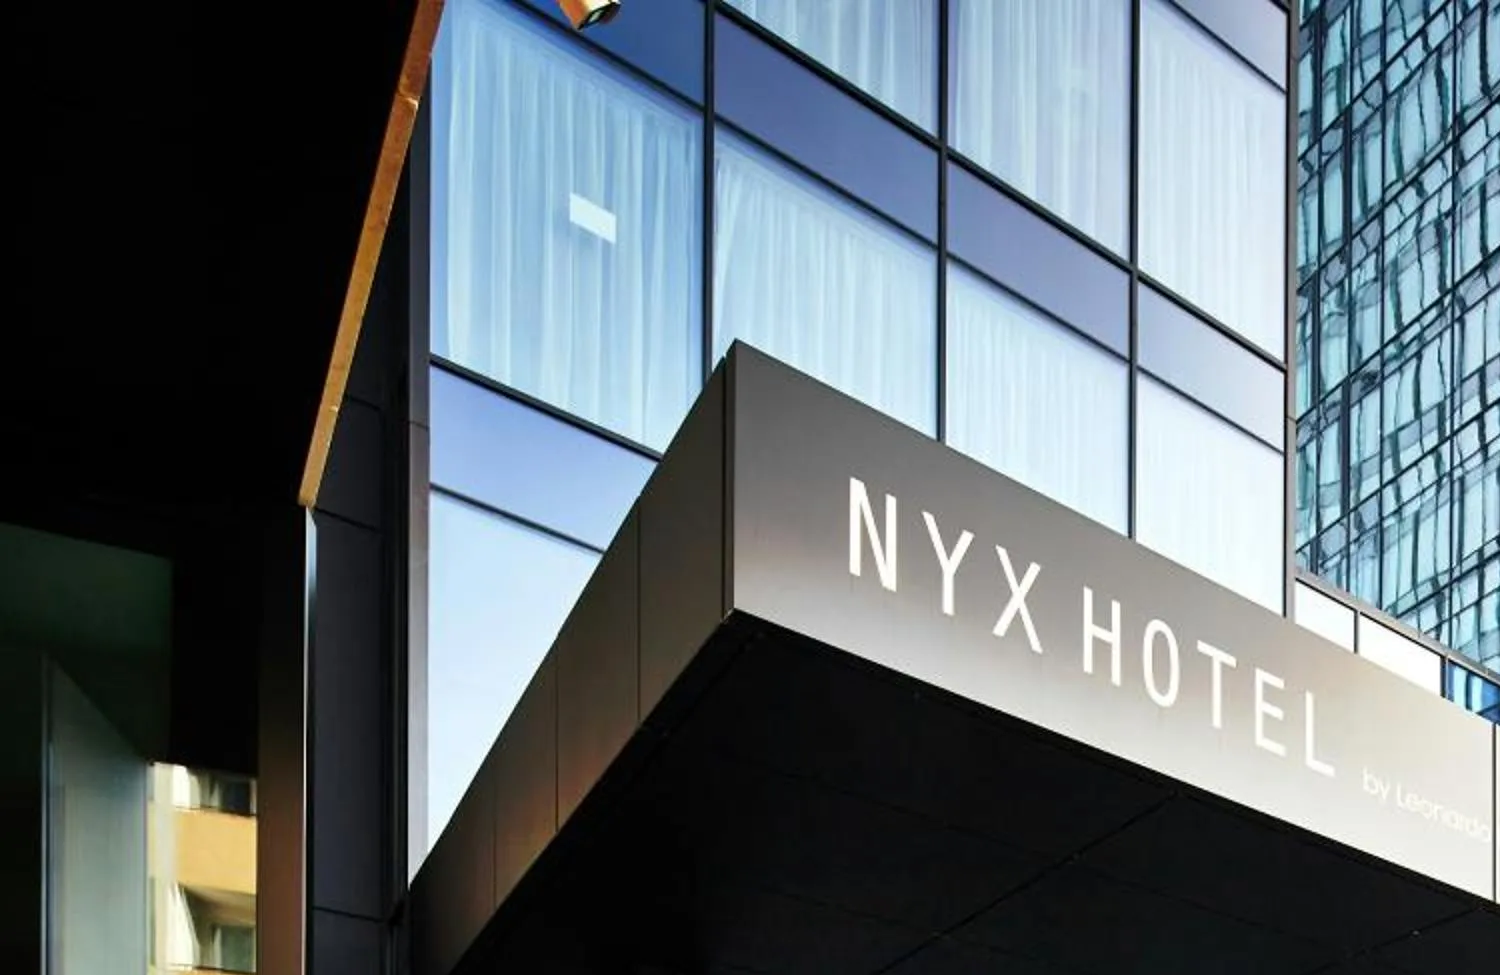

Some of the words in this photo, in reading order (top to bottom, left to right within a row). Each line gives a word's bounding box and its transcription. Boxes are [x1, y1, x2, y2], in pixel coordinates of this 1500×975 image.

[848, 475, 1044, 655] NYX
[1081, 585, 1336, 777] HOTEL
[1362, 765, 1391, 804] by
